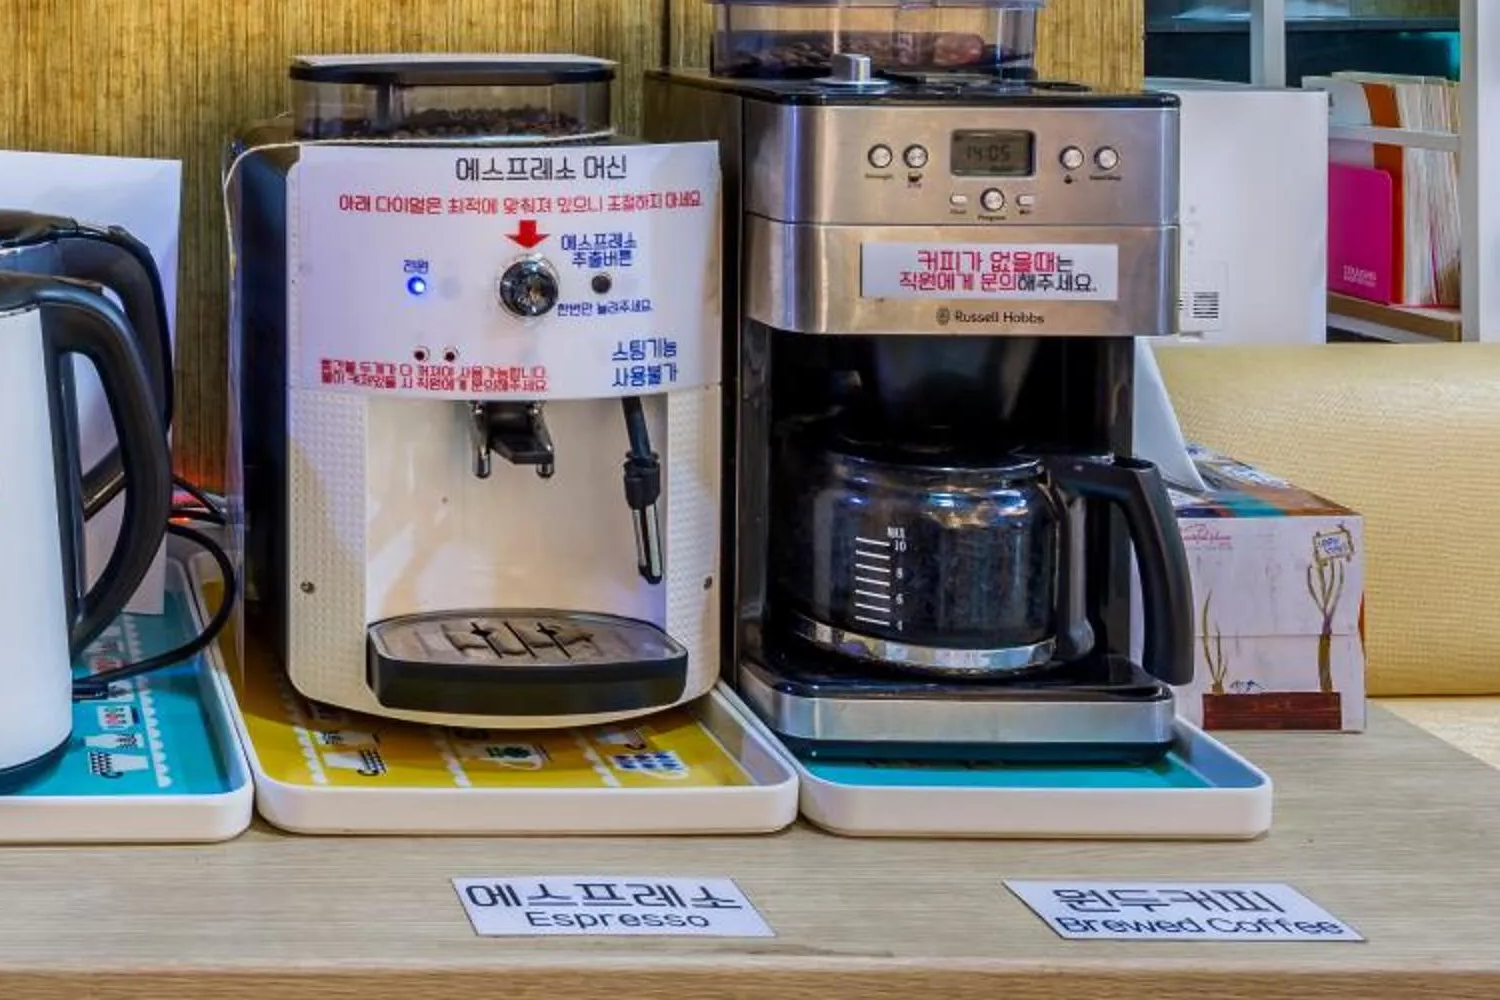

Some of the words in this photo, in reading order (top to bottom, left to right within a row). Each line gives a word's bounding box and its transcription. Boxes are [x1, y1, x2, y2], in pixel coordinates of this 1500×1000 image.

[455, 156, 577, 181] 에스프레소
[583, 155, 628, 180] 머신
[339, 194, 371, 213] 아래
[375, 195, 442, 215] 다이얼은
[557, 194, 603, 214] 있으니
[608, 192, 663, 213] 조절하지
[560, 231, 638, 251] 에스프레소
[403, 258, 429, 274] 전원
[572, 250, 633, 268] 추출버튼
[917, 250, 982, 273] 커피가
[990, 250, 1074, 273] 없을때는
[899, 272, 975, 293] 직원에게
[980, 272, 1098, 293] 문의해주세요.
[954, 311, 1000, 323] Russell
[1003, 311, 1045, 324] Hobbs
[611, 337, 677, 361] 스팀기능
[611, 362, 678, 387] 사용불가
[464, 883, 743, 908] 에스프레소
[1052, 889, 1286, 913] 원두커피
[525, 911, 710, 928] Espresso
[1055, 917, 1203, 934] Brewed
[1206, 917, 1345, 935] Coffee
